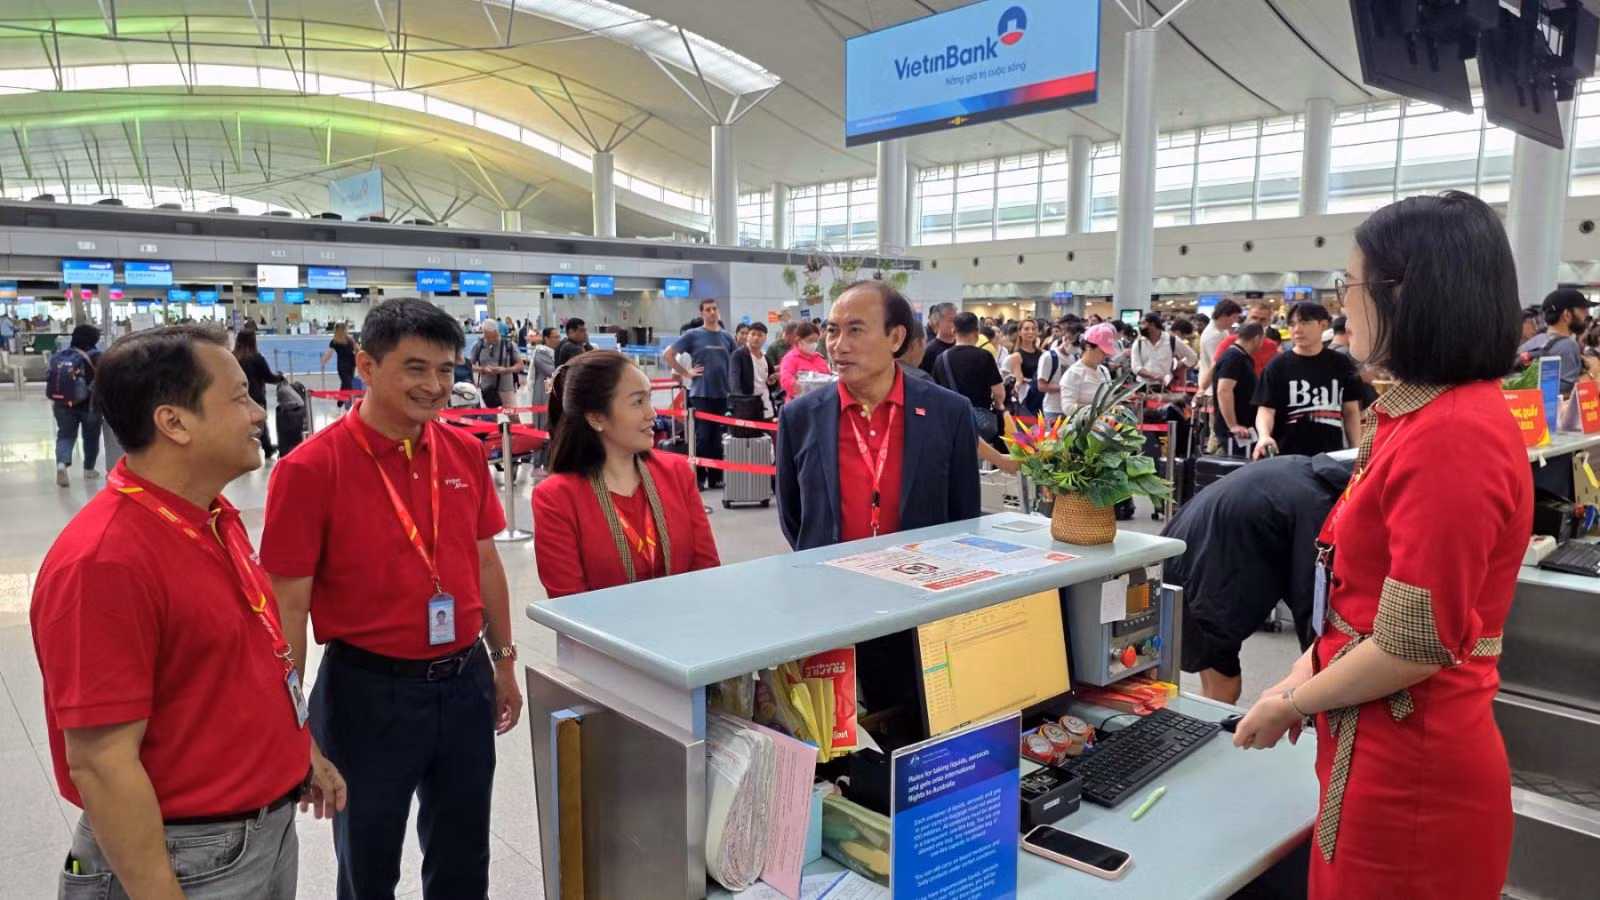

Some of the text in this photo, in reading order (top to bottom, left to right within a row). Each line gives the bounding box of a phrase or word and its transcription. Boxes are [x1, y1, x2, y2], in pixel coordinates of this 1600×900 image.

[908, 774, 924, 783] Rules
[924, 769, 932, 777] for
[933, 763, 950, 775] taking
[908, 783, 919, 793] and
[919, 779, 932, 790] gels
[944, 763, 976, 779] international
[908, 791, 926, 803] flights
[932, 780, 956, 793] Australia
